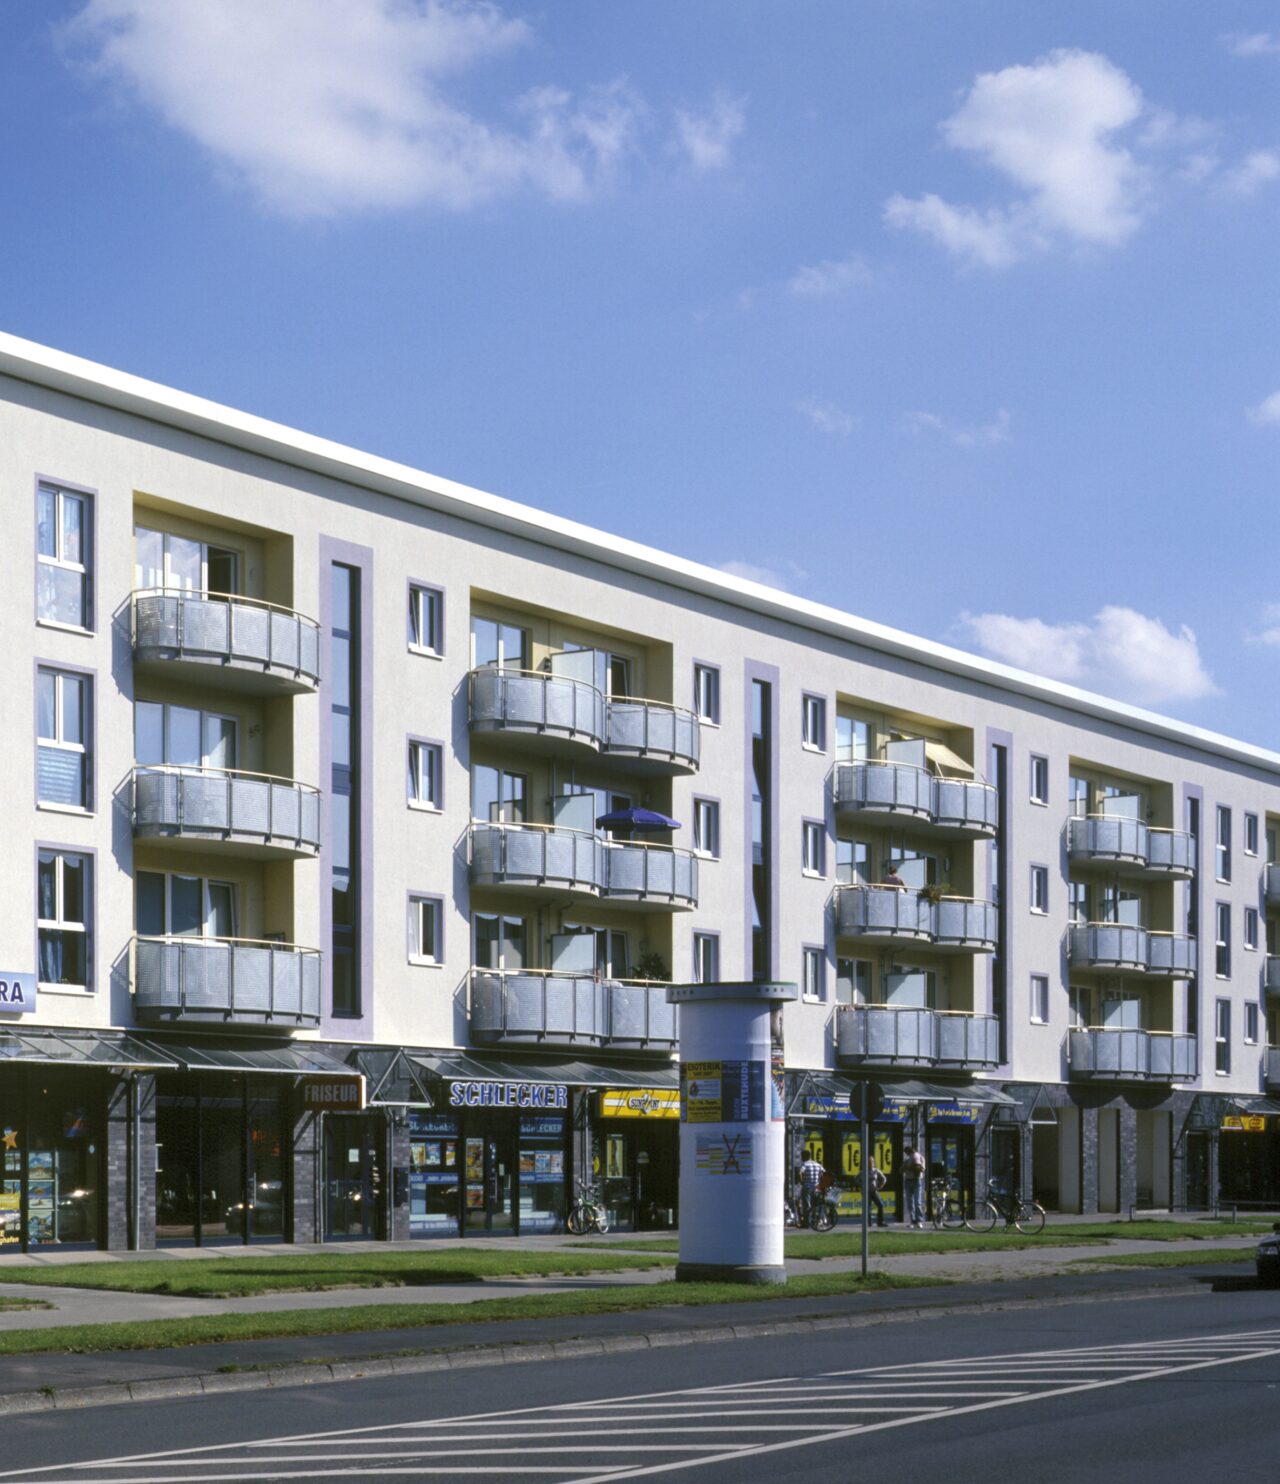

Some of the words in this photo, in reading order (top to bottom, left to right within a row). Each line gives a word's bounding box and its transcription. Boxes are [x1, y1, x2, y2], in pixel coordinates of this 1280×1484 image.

[304, 1084, 358, 1102] FRISEUR
[450, 1081, 568, 1109] SCHLECKER
[741, 1061, 749, 1120] BUXTEHUDE
